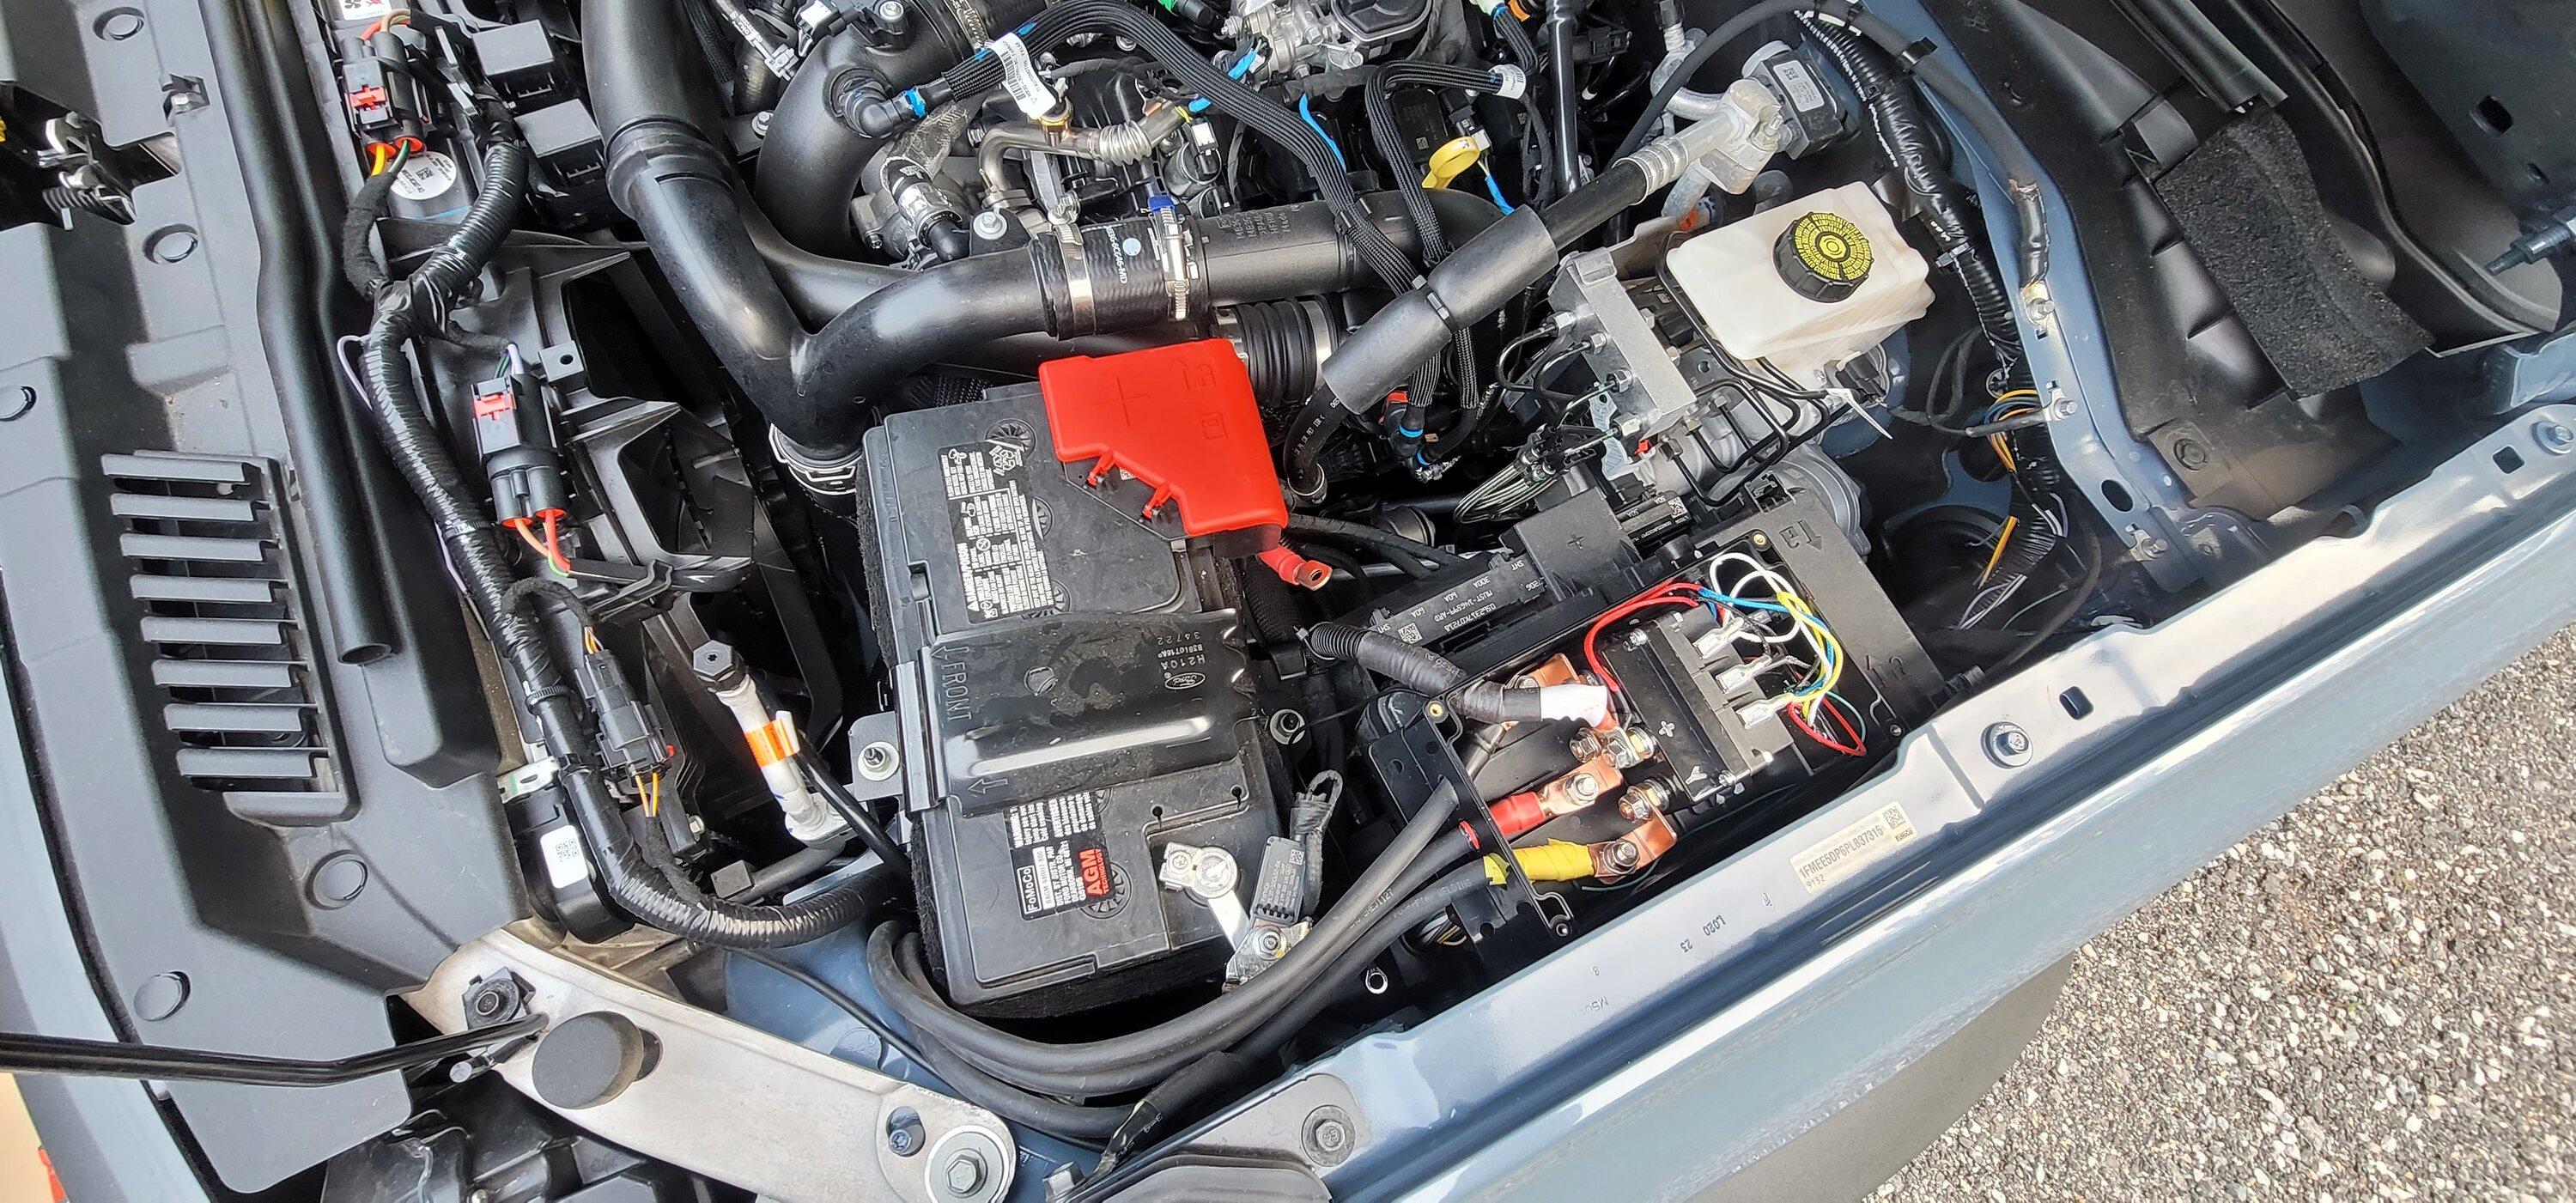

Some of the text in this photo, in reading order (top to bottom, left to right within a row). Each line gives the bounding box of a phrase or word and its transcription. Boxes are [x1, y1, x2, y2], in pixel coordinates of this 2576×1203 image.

[1472, 575, 1491, 588] 300A
[1160, 653, 1205, 670] H210A
[1172, 674, 1198, 687] Ford
[940, 661, 971, 722] FRONT
[1057, 864, 1067, 886] MOTOR
[1078, 848, 1103, 896] AGM
[1095, 848, 1109, 893] TECHNOLOGY
[1021, 867, 1038, 910] FoMoCo
[1805, 873, 1826, 890] 9132
[1061, 886, 1071, 903] FORD
